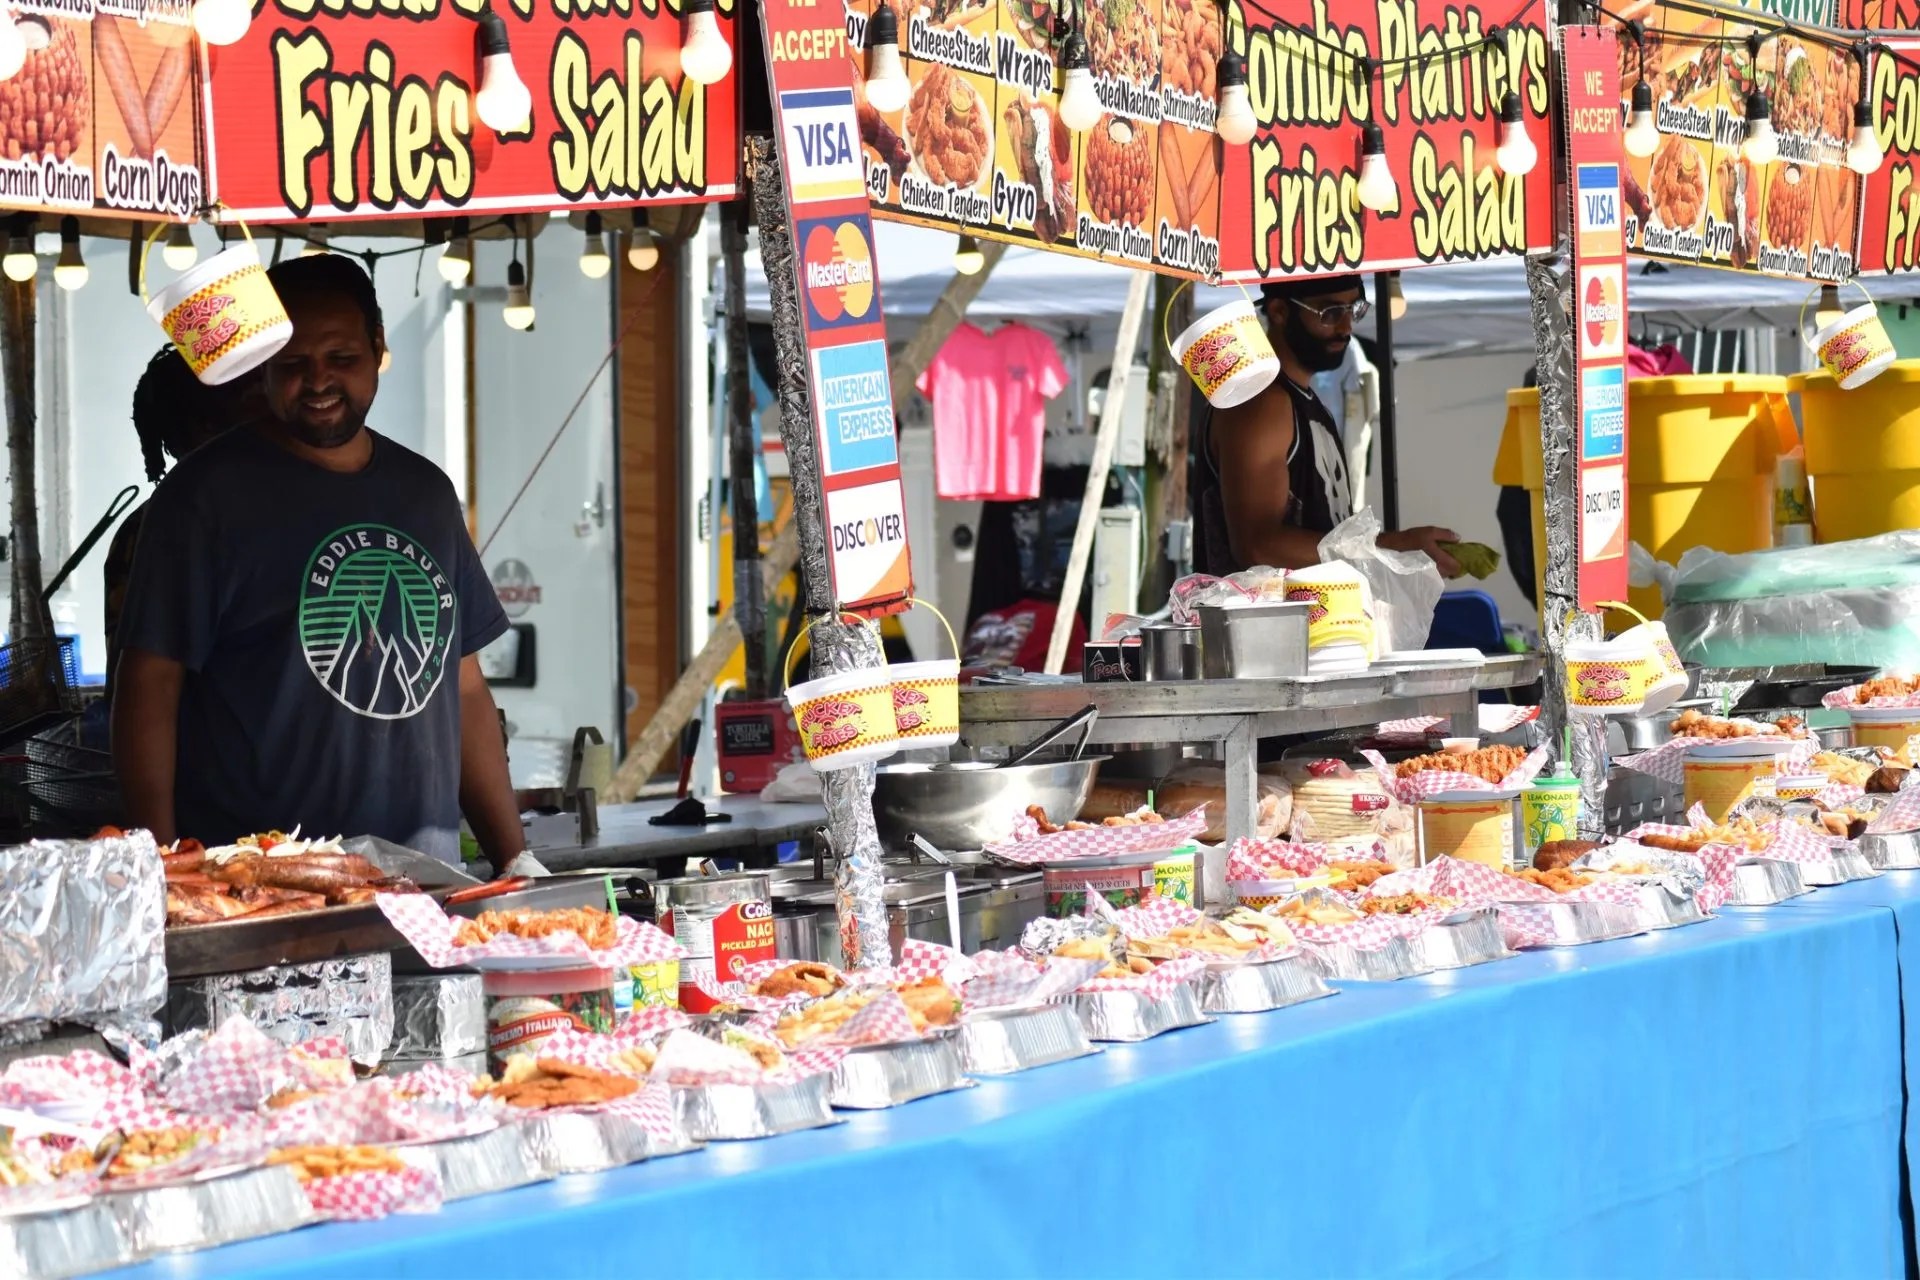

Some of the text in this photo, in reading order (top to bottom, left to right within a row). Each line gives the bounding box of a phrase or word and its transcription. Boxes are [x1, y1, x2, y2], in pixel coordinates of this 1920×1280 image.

[772, 28, 847, 62] ACCEPT
[846, 14, 865, 48] oy
[912, 20, 990, 68] CheeseSteak
[998, 41, 1051, 98] Wraps
[1378, 0, 1548, 124] Platters
[1094, 77, 1160, 120] adedNachos
[1584, 71, 1603, 96] WE
[272, 28, 472, 216] Fries
[551, 30, 707, 198] Salad
[1163, 87, 1215, 127] ShrimpBask
[1573, 108, 1618, 134] ACCEPT
[1658, 101, 1712, 134] CheeseSteak
[1873, 53, 1920, 155] Co
[792, 122, 853, 167] VISA
[45, 160, 90, 202] Onion
[105, 150, 199, 216] Corn Dogs
[902, 178, 988, 220] Chicken Tenders
[995, 176, 1035, 222] Gyro
[1412, 128, 1527, 261] Salad
[1250, 134, 1363, 276] Fries
[1585, 194, 1615, 225] VISA
[1885, 166, 1920, 274] Fr
[1079, 218, 1151, 259] Bloomin Onion
[1625, 219, 1637, 245] eg
[1644, 226, 1672, 249] Chicken
[1705, 216, 1733, 256] Gyro
[1159, 227, 1218, 276] Corn Dogs
[1787, 248, 1806, 274] Onion
[1812, 245, 1851, 280] Corn Dogs
[807, 257, 871, 290] MasterCard
[174, 294, 235, 345] BUCKET
[192, 317, 240, 358] FRIES
[1203, 351, 1239, 383] FRIES
[824, 373, 884, 406] AMERICAN
[840, 407, 893, 441] EXPRESS
[1592, 414, 1623, 434] EXPRESS
[1586, 490, 1620, 514] DISCOVER
[833, 513, 902, 551] DISCOVER
[311, 531, 453, 609] EDDIE BAUER
[420, 636, 444, 693] 1920
[1576, 666, 1631, 684] BUCKET
[893, 688, 928, 704] KET
[1584, 687, 1624, 700] FRIES
[800, 701, 863, 732] BUCKET
[812, 724, 859, 748] FRIES
[1527, 793, 1573, 801] LEMONADE
[721, 939, 757, 951] PICKLED
[746, 921, 774, 939] NAC
